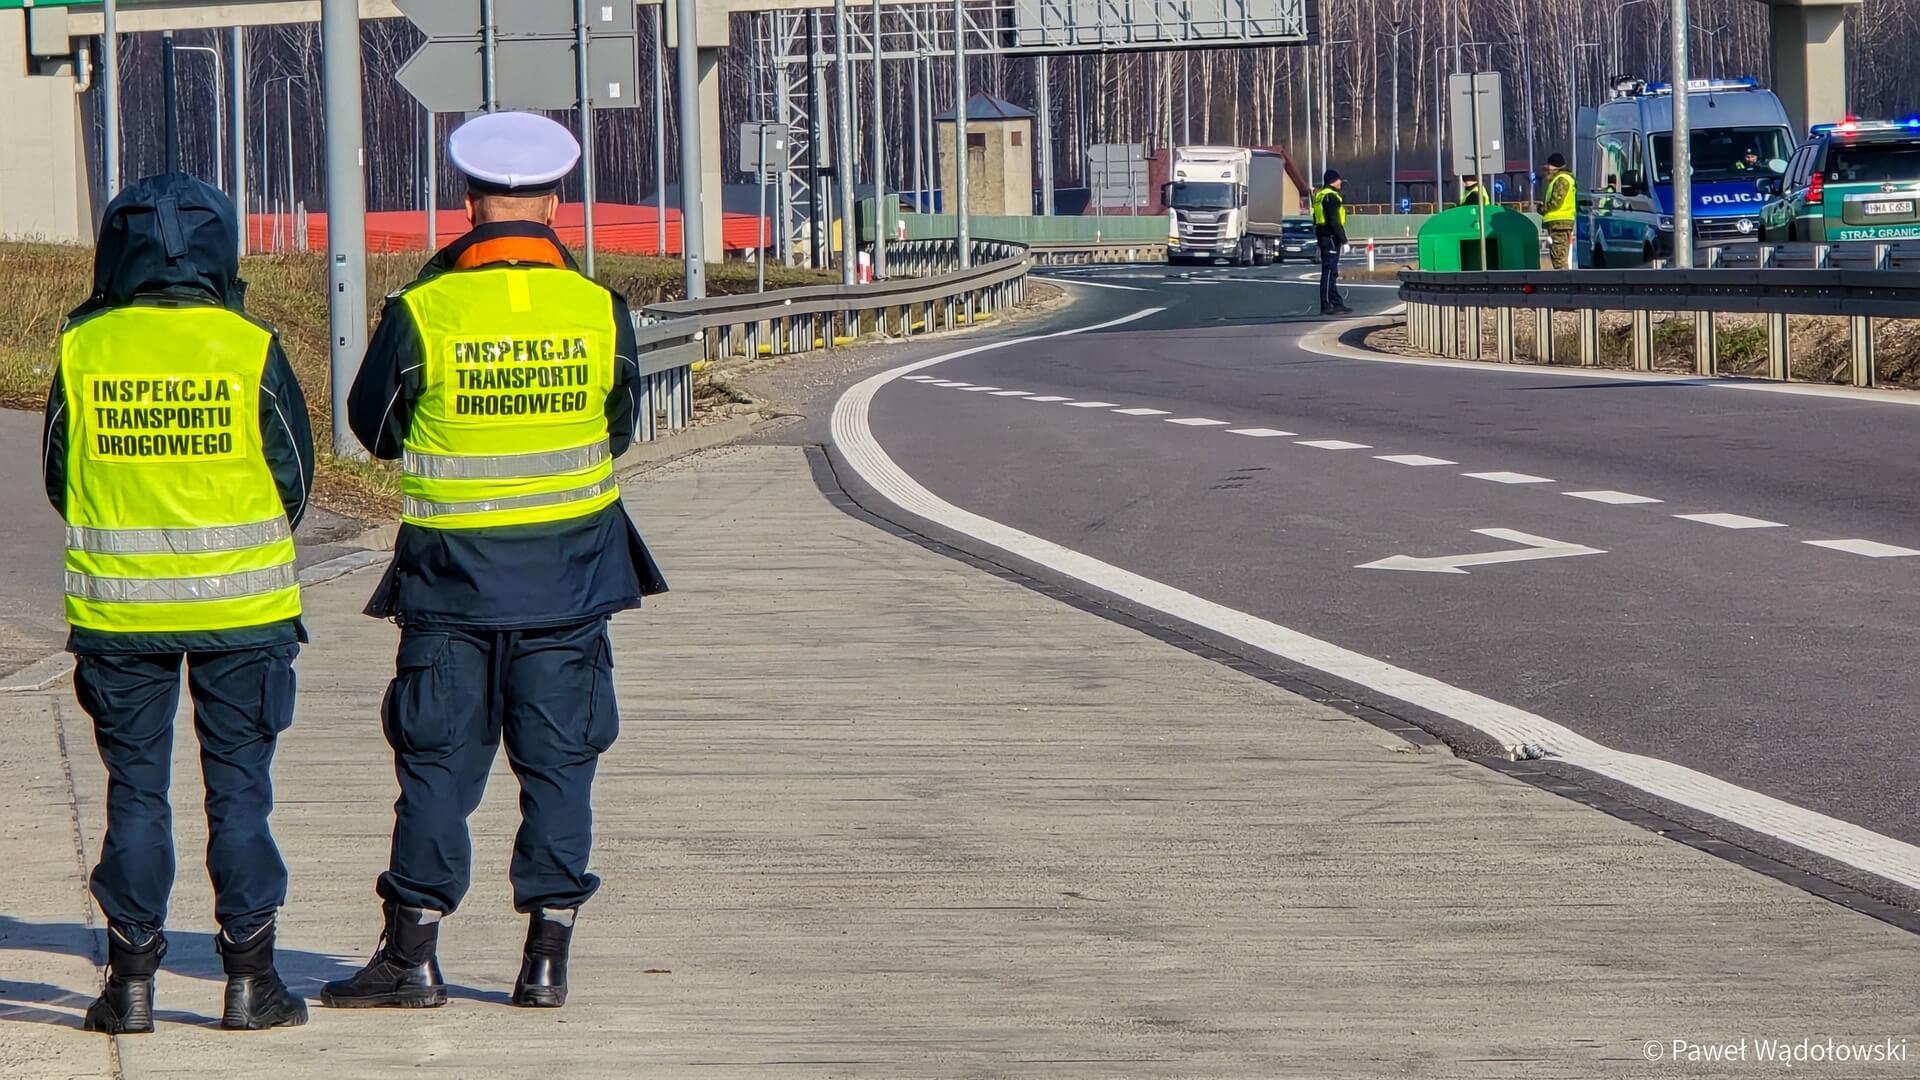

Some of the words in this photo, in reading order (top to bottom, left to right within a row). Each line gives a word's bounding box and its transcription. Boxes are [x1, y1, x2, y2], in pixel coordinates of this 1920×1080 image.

[1840, 227, 1876, 240] STRAŻ
[1878, 227, 1920, 238] GRANIC
[455, 338, 588, 364] INSPEKCJA
[456, 364, 589, 390] TRANSPORTU
[93, 379, 231, 402] INSPEKCJA
[456, 391, 588, 416] DROGOWEGO
[94, 406, 232, 430] TRANSPORTU
[96, 432, 233, 457] DROGOWEGO
